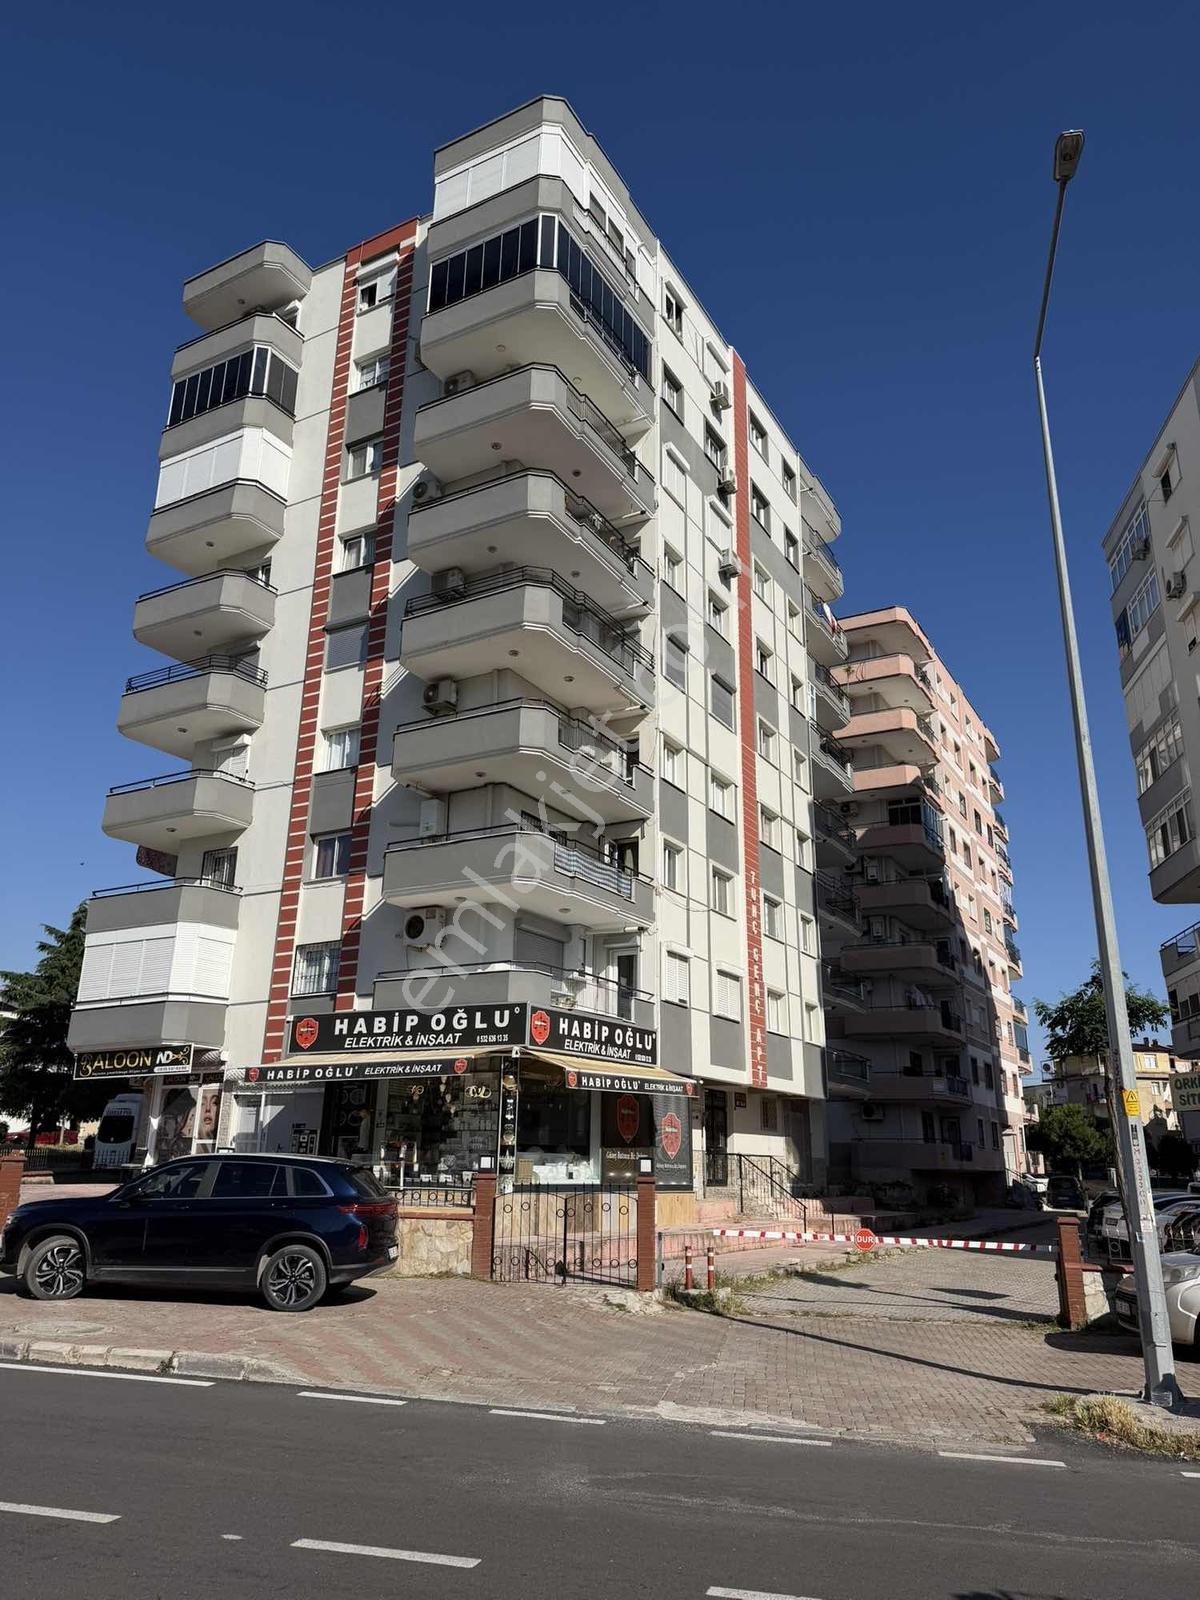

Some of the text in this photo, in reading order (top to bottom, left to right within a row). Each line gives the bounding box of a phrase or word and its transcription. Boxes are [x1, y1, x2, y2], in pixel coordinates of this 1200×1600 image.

[334, 1012, 419, 1036] HABİP
[559, 1017, 609, 1042] HABİP
[344, 1032, 462, 1048] ELEKTRİK & İNŞAAT
[564, 1038, 600, 1054] ELEKTRİK
[600, 1045, 606, 1056] &
[607, 1045, 631, 1059] İNŞAAT
[266, 1067, 310, 1080] HABİP
[364, 1064, 405, 1075] ELEKTRİK
[404, 1065, 411, 1073] &
[411, 1063, 443, 1074] İNŞAAT
[581, 1076, 611, 1089] HABİP
[644, 1082, 666, 1091] ELEKTRİK
[856, 1235, 874, 1243] DUR
